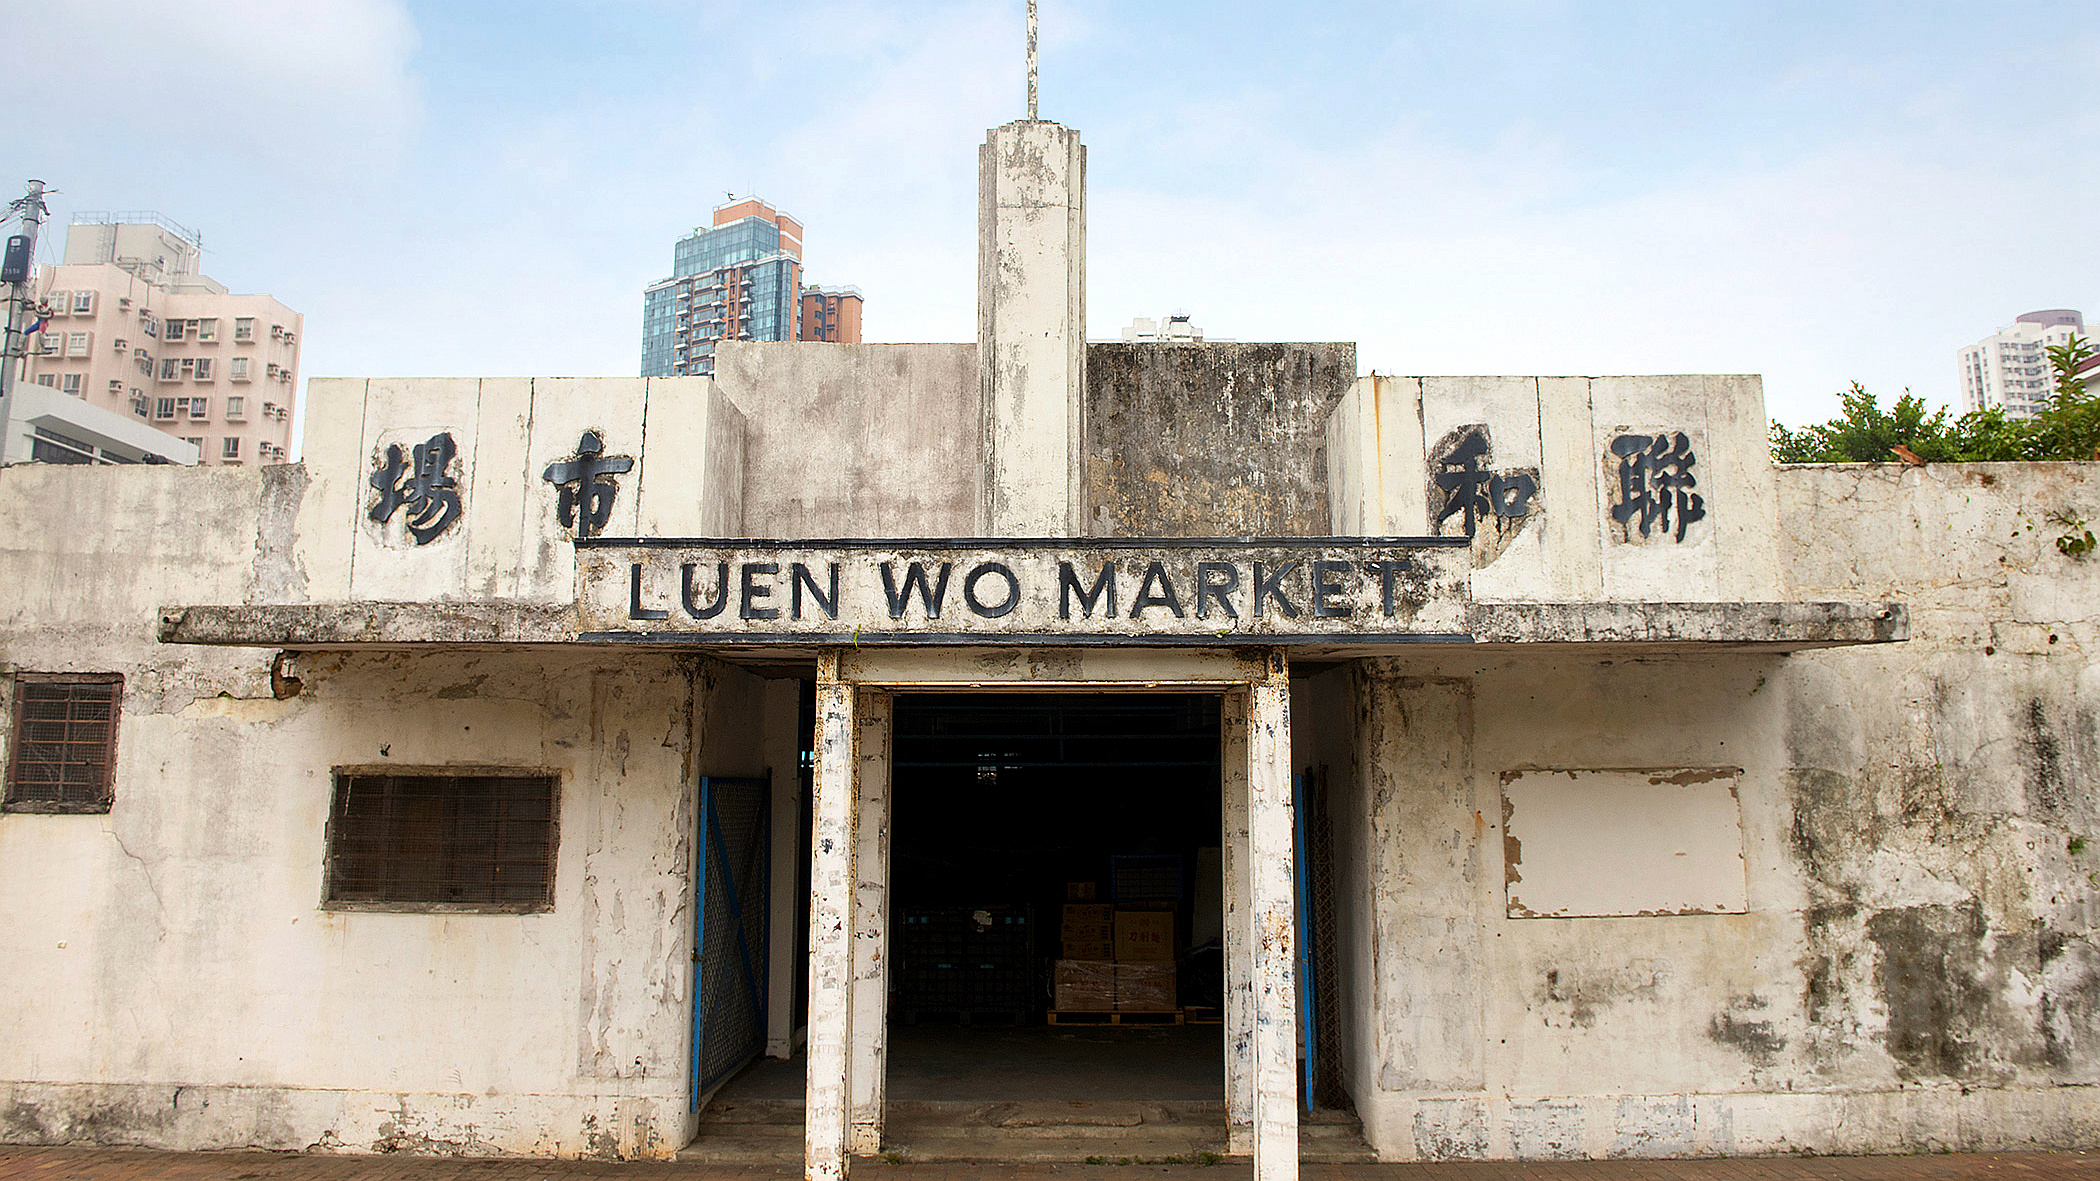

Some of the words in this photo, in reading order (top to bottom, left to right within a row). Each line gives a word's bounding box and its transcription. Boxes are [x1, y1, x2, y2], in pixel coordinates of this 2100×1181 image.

[629, 562, 840, 620] LUEN
[880, 562, 1020, 620] WO
[1058, 560, 1412, 619] MARKET
